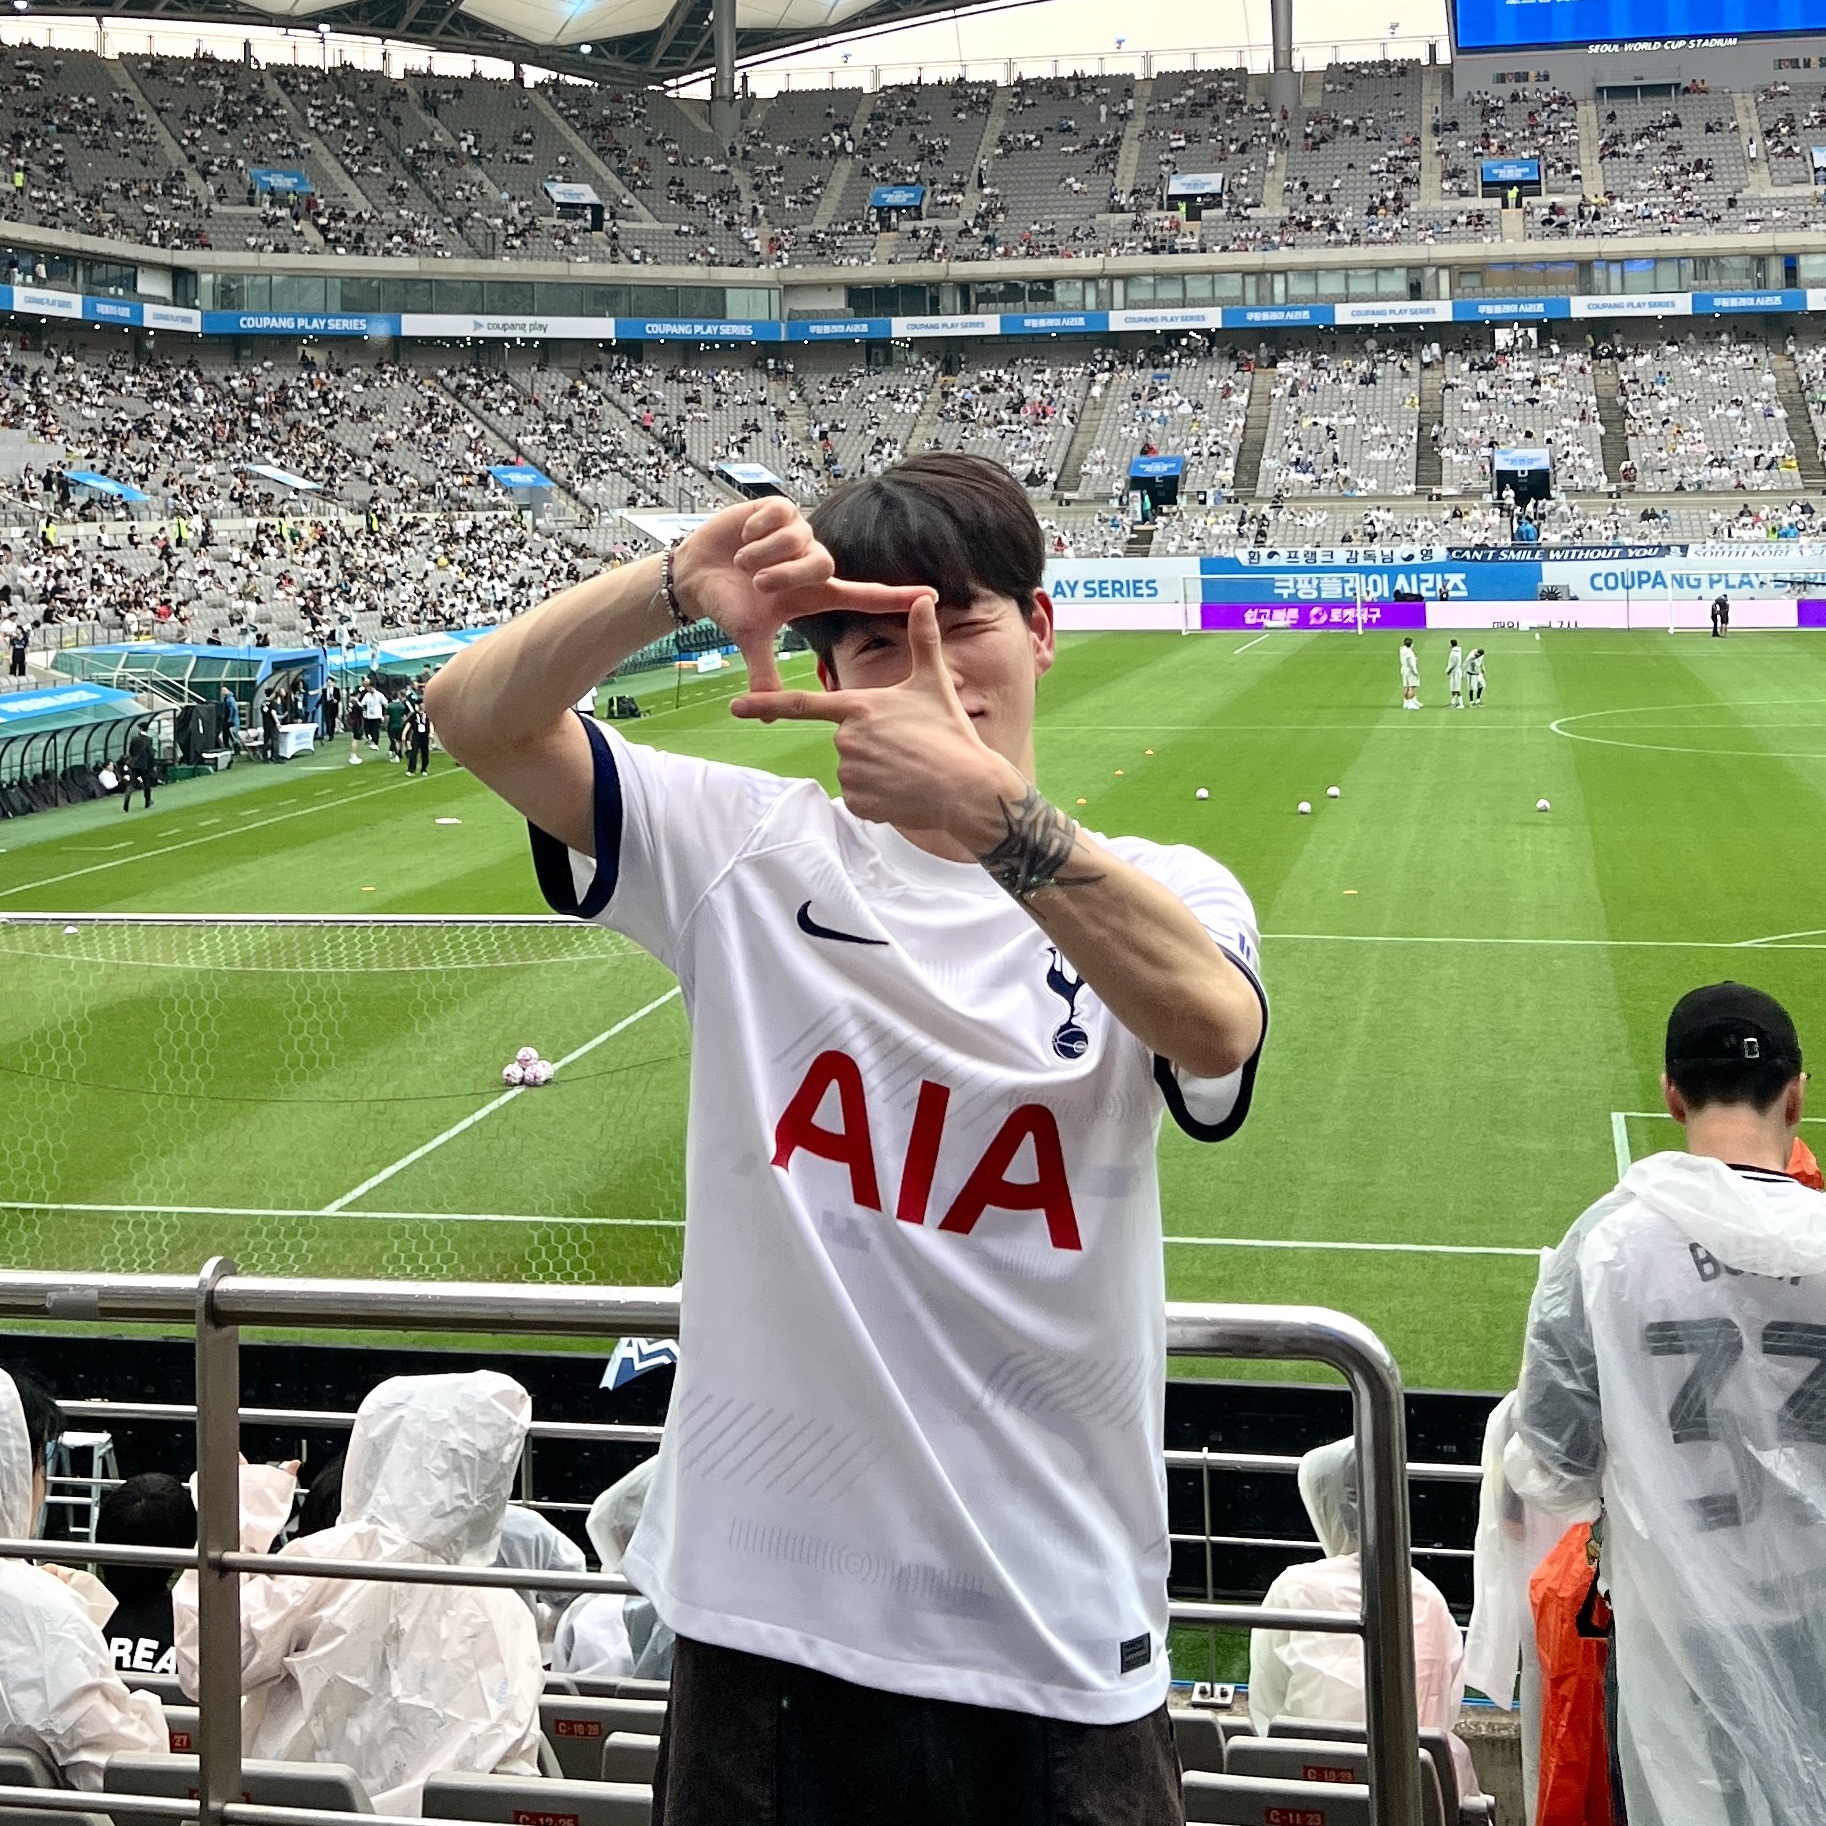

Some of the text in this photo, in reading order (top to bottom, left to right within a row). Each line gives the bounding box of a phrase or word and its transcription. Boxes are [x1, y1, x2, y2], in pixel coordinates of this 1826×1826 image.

[1587, 38, 1738, 54] SEOUL WORLD CUP STADIUM
[1351, 307, 1436, 317] COUPANG PLAY SERIES
[1587, 300, 1676, 310] COUPANG PLAY SERIES
[240, 316, 367, 330] COUPANG PLAY SERIES
[906, 321, 985, 331] COUPANG PLAY SERIES
[1124, 314, 1206, 324] COUPANG PLAY SERIES
[487, 320, 548, 333] coupang play
[645, 323, 753, 336] COUPANG PLAY SERIES
[1286, 549, 1335, 564] 프랭크
[1346, 549, 1395, 563] 감독님
[1420, 548, 1433, 561] 영
[1451, 547, 1660, 561] CAN'T SMILE WITHOUT YOU
[1394, 573, 1469, 598] 시리즈
[1589, 570, 1701, 591] COUPANG
[1052, 579, 1158, 598] AY SERIES
[770, 1050, 1083, 1251] AIA
